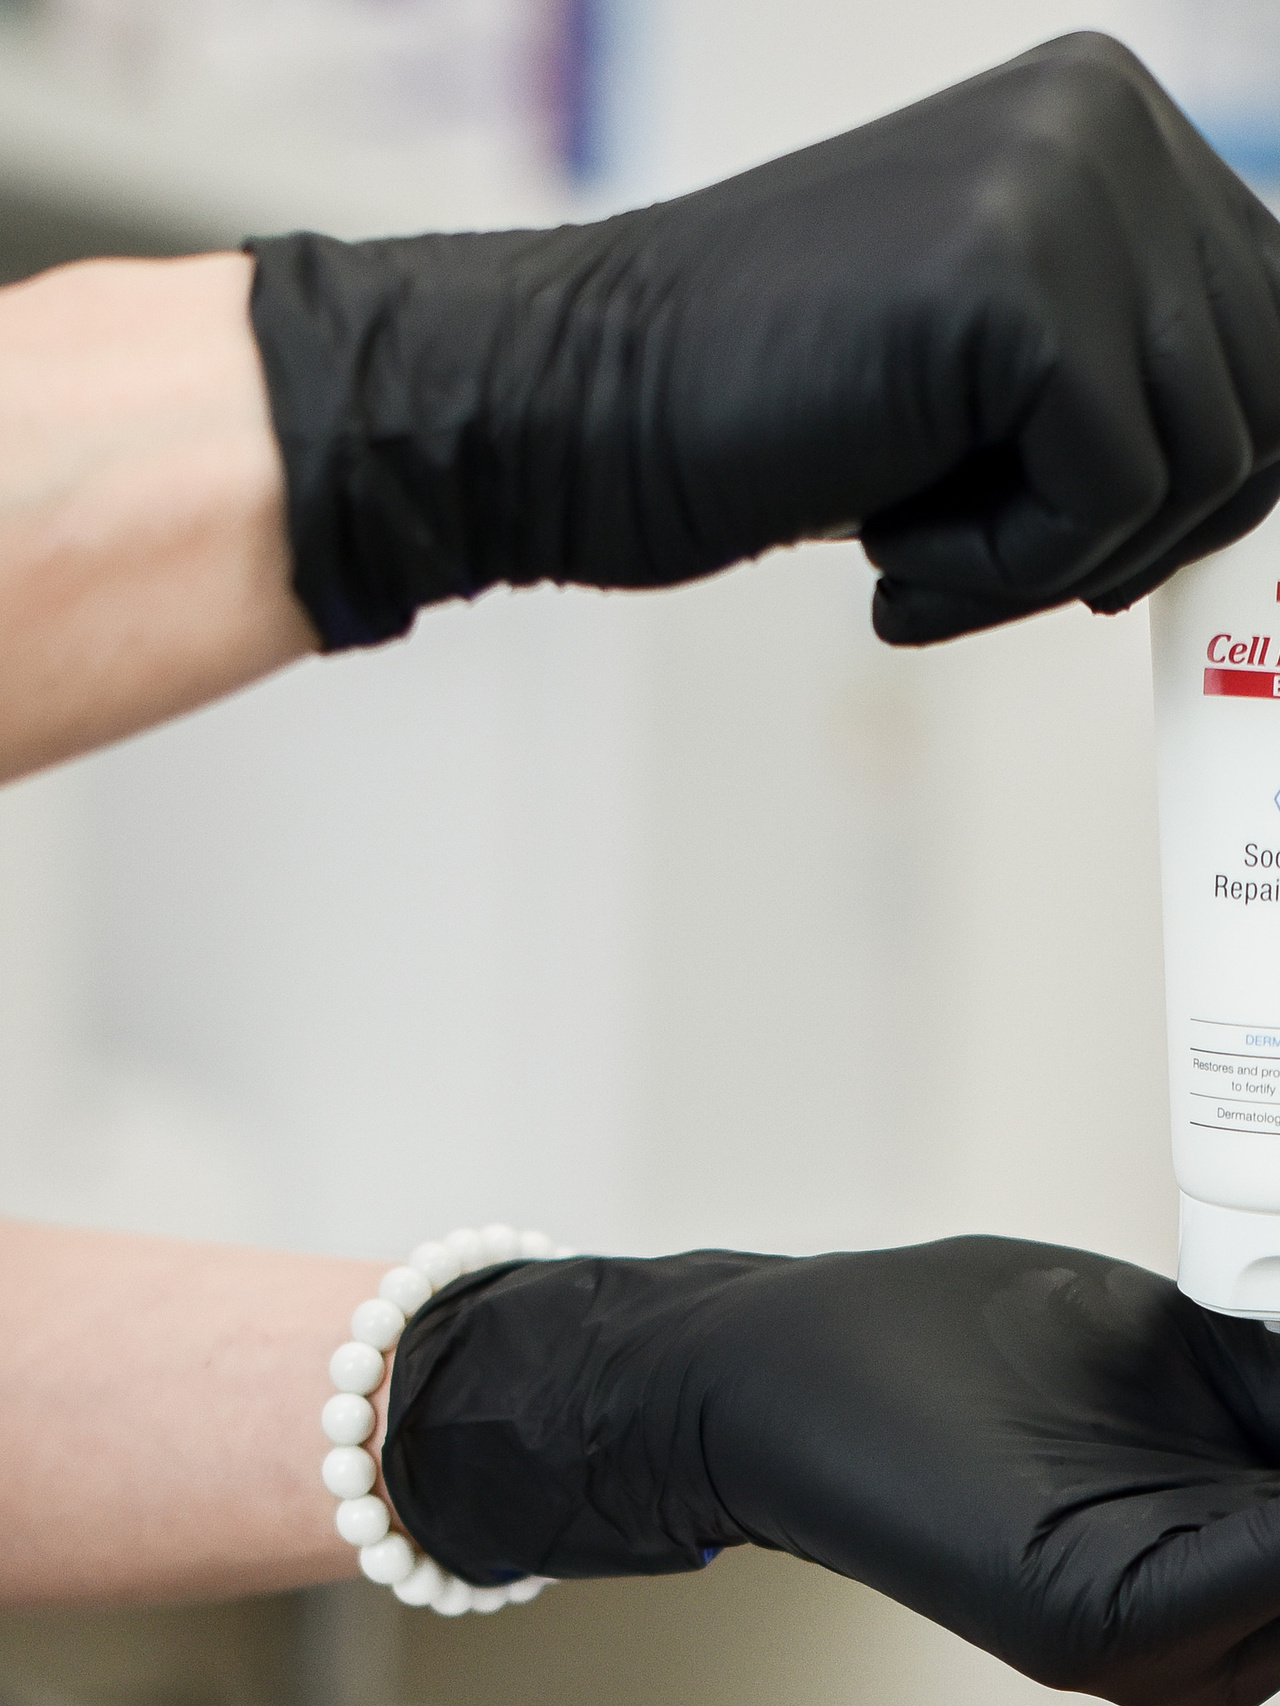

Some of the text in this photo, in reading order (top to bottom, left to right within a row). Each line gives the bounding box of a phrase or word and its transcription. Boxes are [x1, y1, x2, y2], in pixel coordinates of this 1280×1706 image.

[1206, 633, 1271, 666] Cell
[1193, 1057, 1234, 1074] Restores
[1237, 1065, 1258, 1077] and
[1231, 1081, 1242, 1092] to
[1245, 1082, 1276, 1097] fortify
